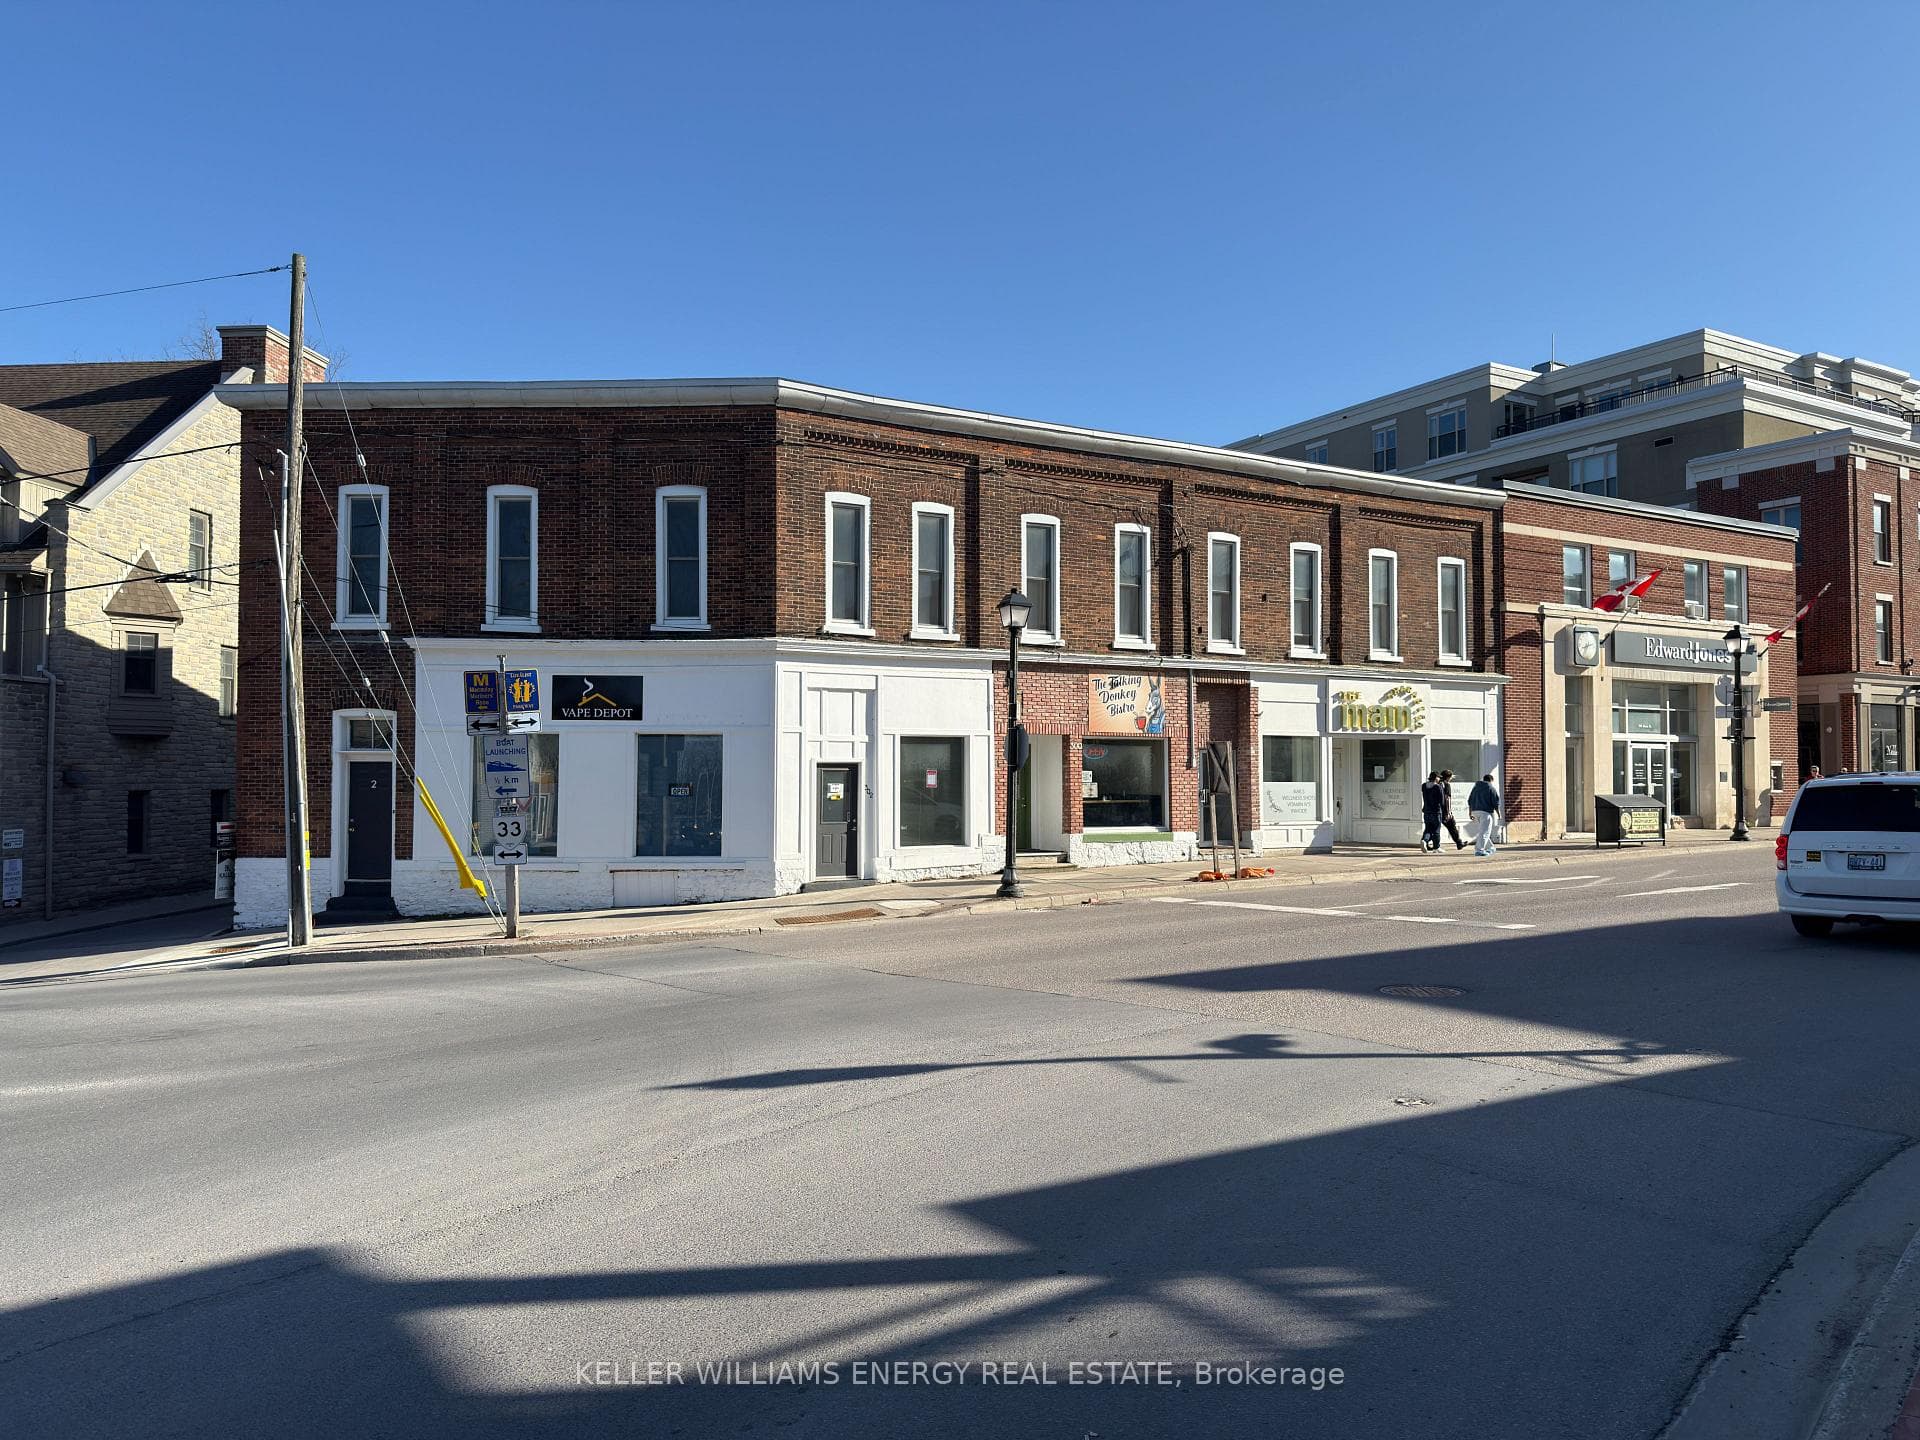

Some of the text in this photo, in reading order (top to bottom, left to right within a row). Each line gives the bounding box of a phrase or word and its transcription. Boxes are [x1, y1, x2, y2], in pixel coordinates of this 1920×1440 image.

[473, 673, 490, 687] M
[1092, 675, 1142, 692] The Talking
[1099, 689, 1137, 704] Donkey
[562, 708, 634, 718] VAPE DEPOT
[1107, 703, 1135, 717] Bistro
[496, 739, 516, 747] BOAT
[485, 747, 527, 756] LAUNCHING
[370, 779, 378, 789] 2
[497, 821, 522, 837] 33
